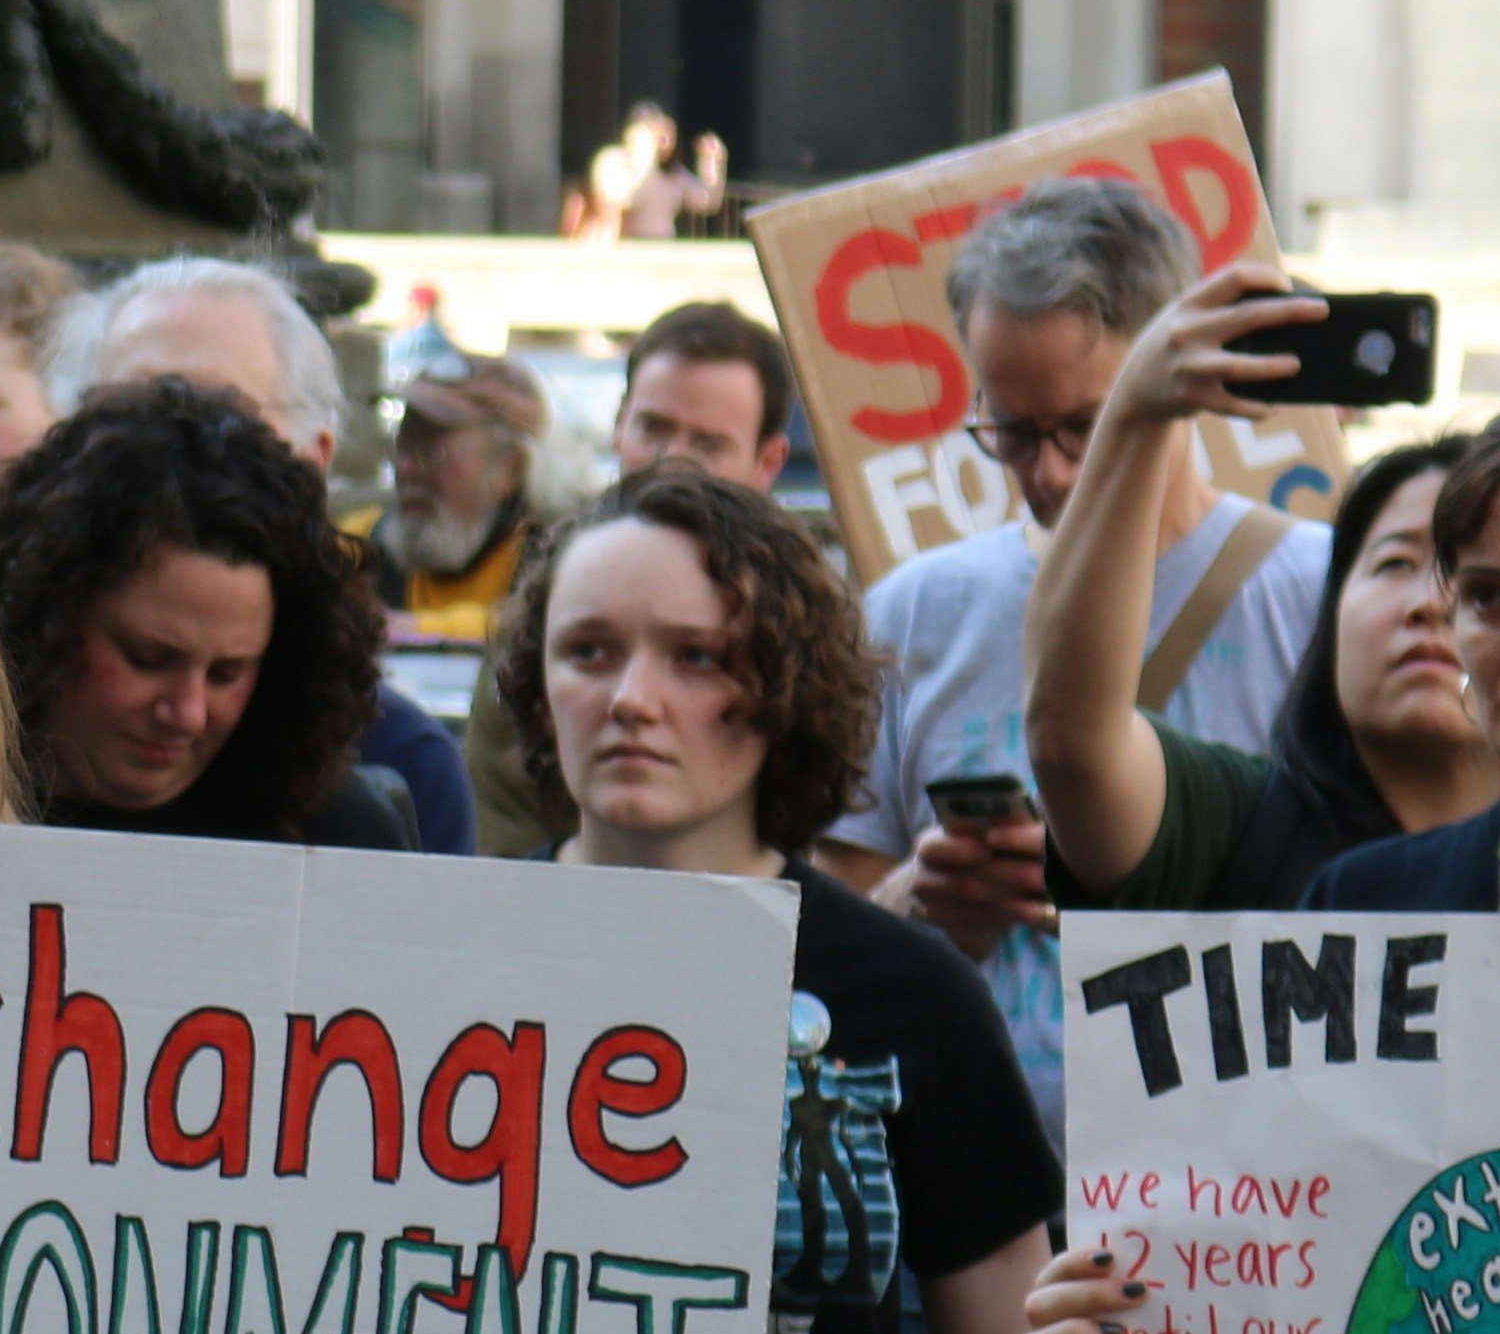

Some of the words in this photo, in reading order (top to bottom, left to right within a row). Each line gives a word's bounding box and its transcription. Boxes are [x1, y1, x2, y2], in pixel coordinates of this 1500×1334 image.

[816, 135, 1258, 444] SP
[1082, 933, 1447, 1097] TIME
[1189, 1165, 1330, 1218] have
[1102, 1230, 1164, 1289] 2
[1174, 1240, 1317, 1291] years
